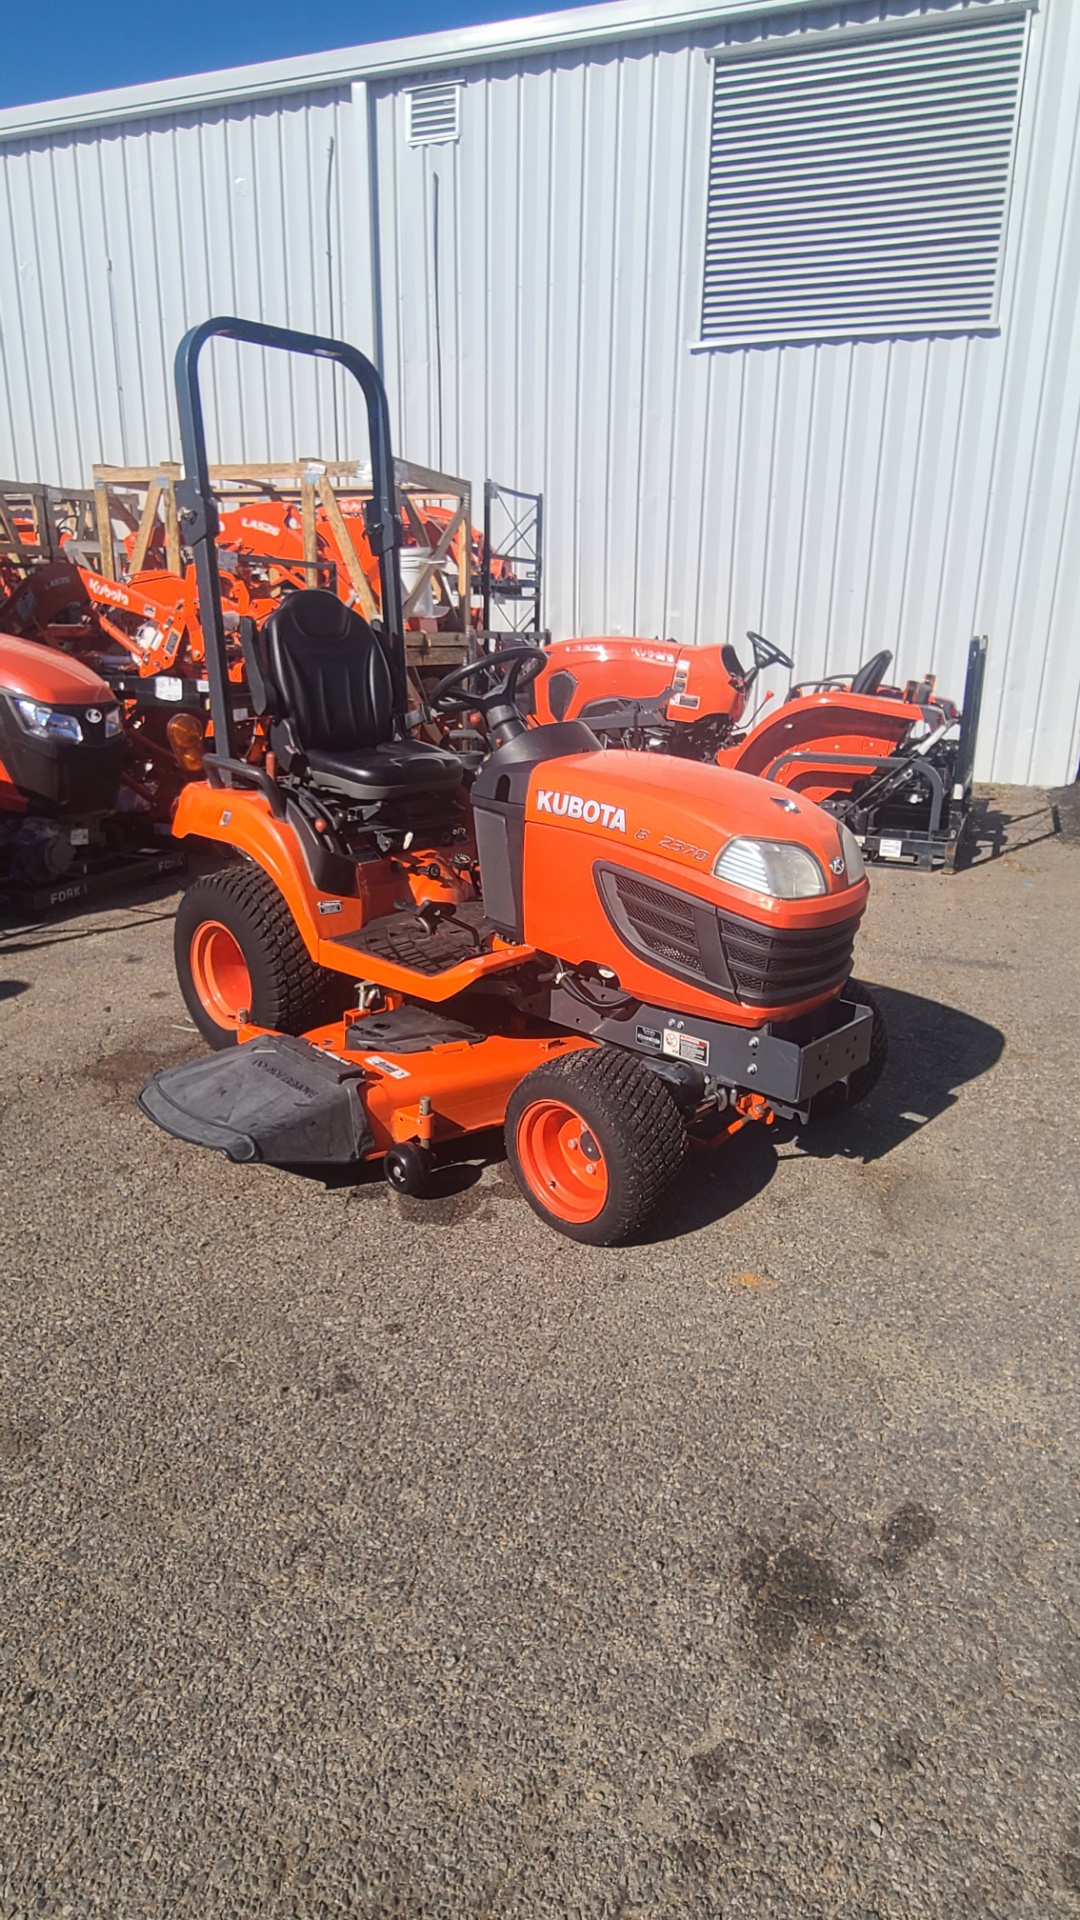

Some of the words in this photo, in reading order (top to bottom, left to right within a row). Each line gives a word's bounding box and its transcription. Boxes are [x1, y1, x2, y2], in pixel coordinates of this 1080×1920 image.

[88, 578, 129, 606] Kubota
[537, 790, 627, 833] KUBOTA
[658, 836, 709, 862] 2370
[50, 885, 82, 905] FORK
